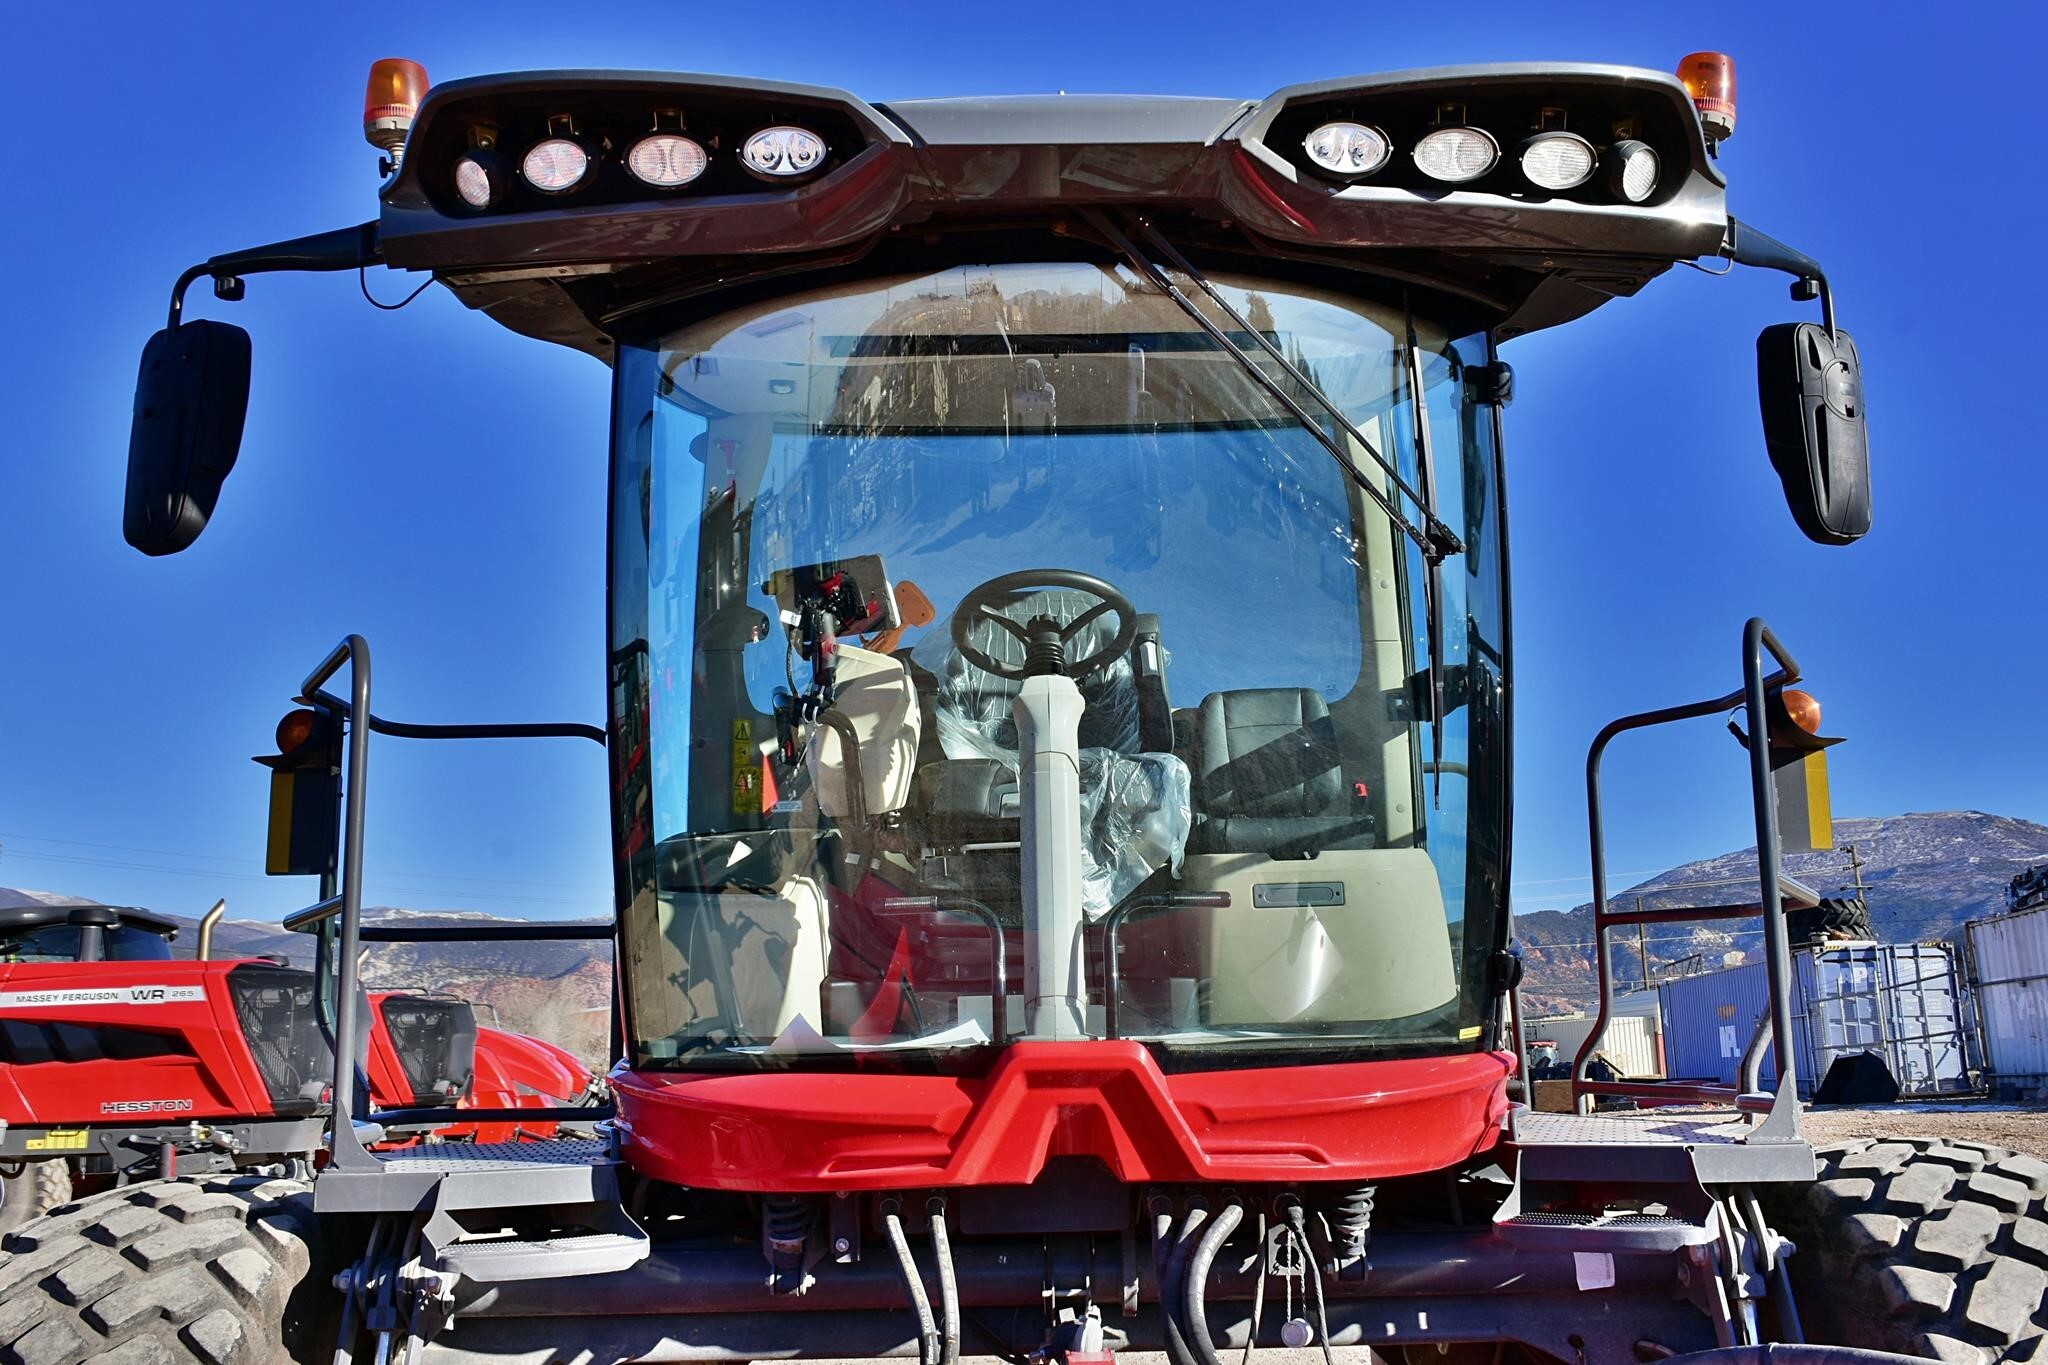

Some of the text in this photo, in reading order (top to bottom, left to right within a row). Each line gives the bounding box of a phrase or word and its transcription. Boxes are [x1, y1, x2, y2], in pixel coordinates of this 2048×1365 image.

[16, 994, 59, 1003] MASSEY
[62, 992, 119, 1002] FERGUSON
[131, 989, 165, 1000] WR
[101, 1100, 192, 1113] HESSTON
